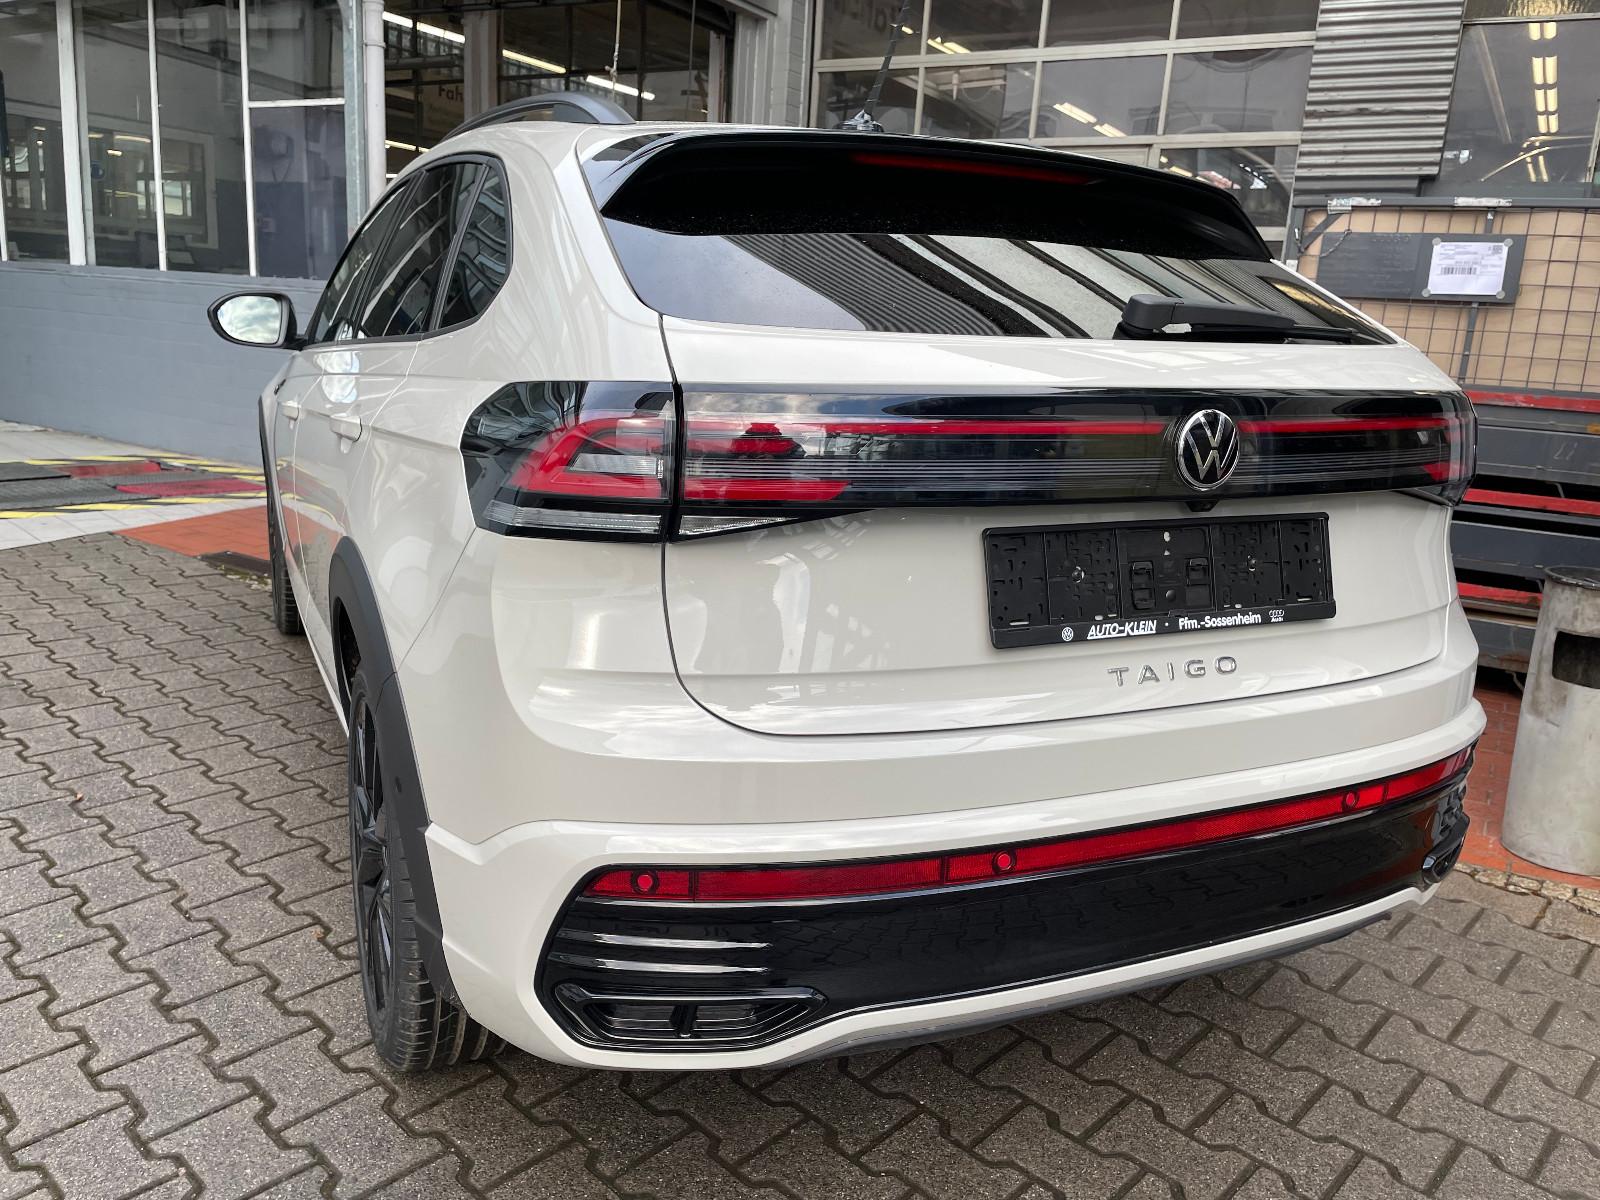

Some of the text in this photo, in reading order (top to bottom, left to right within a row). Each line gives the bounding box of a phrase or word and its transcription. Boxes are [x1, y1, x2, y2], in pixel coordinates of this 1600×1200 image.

[1180, 409, 1238, 486] VW
[1087, 620, 1157, 639] AUTO-KLEIN
[1178, 612, 1262, 630] Ffm.-Sossenheim
[1108, 656, 1237, 687] TAIGO
